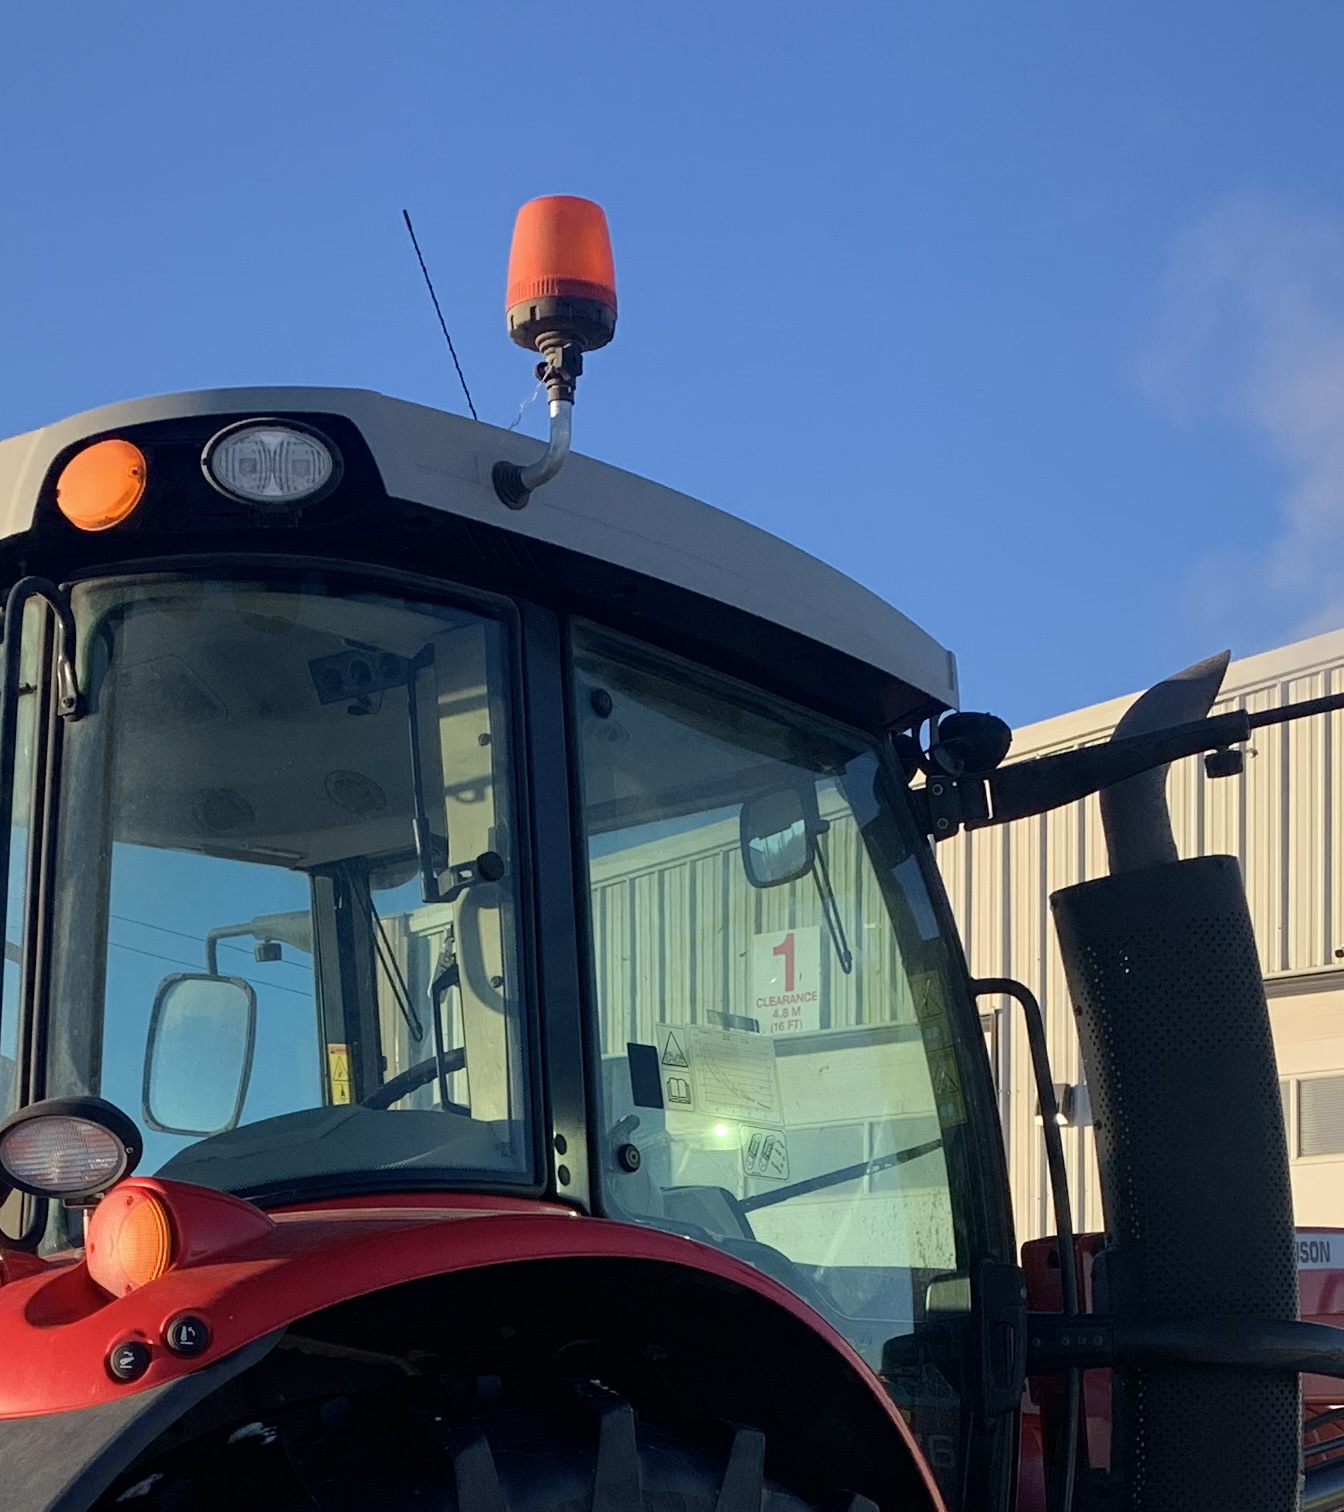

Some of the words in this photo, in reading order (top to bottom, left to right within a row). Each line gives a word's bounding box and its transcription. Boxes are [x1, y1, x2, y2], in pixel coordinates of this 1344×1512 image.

[772, 932, 795, 992] 1
[756, 990, 818, 1008] CLEARANCE
[772, 1007, 790, 1019] 4.8
[791, 1006, 801, 1017] M
[770, 1021, 785, 1034] (16
[787, 1019, 803, 1032] FT)
